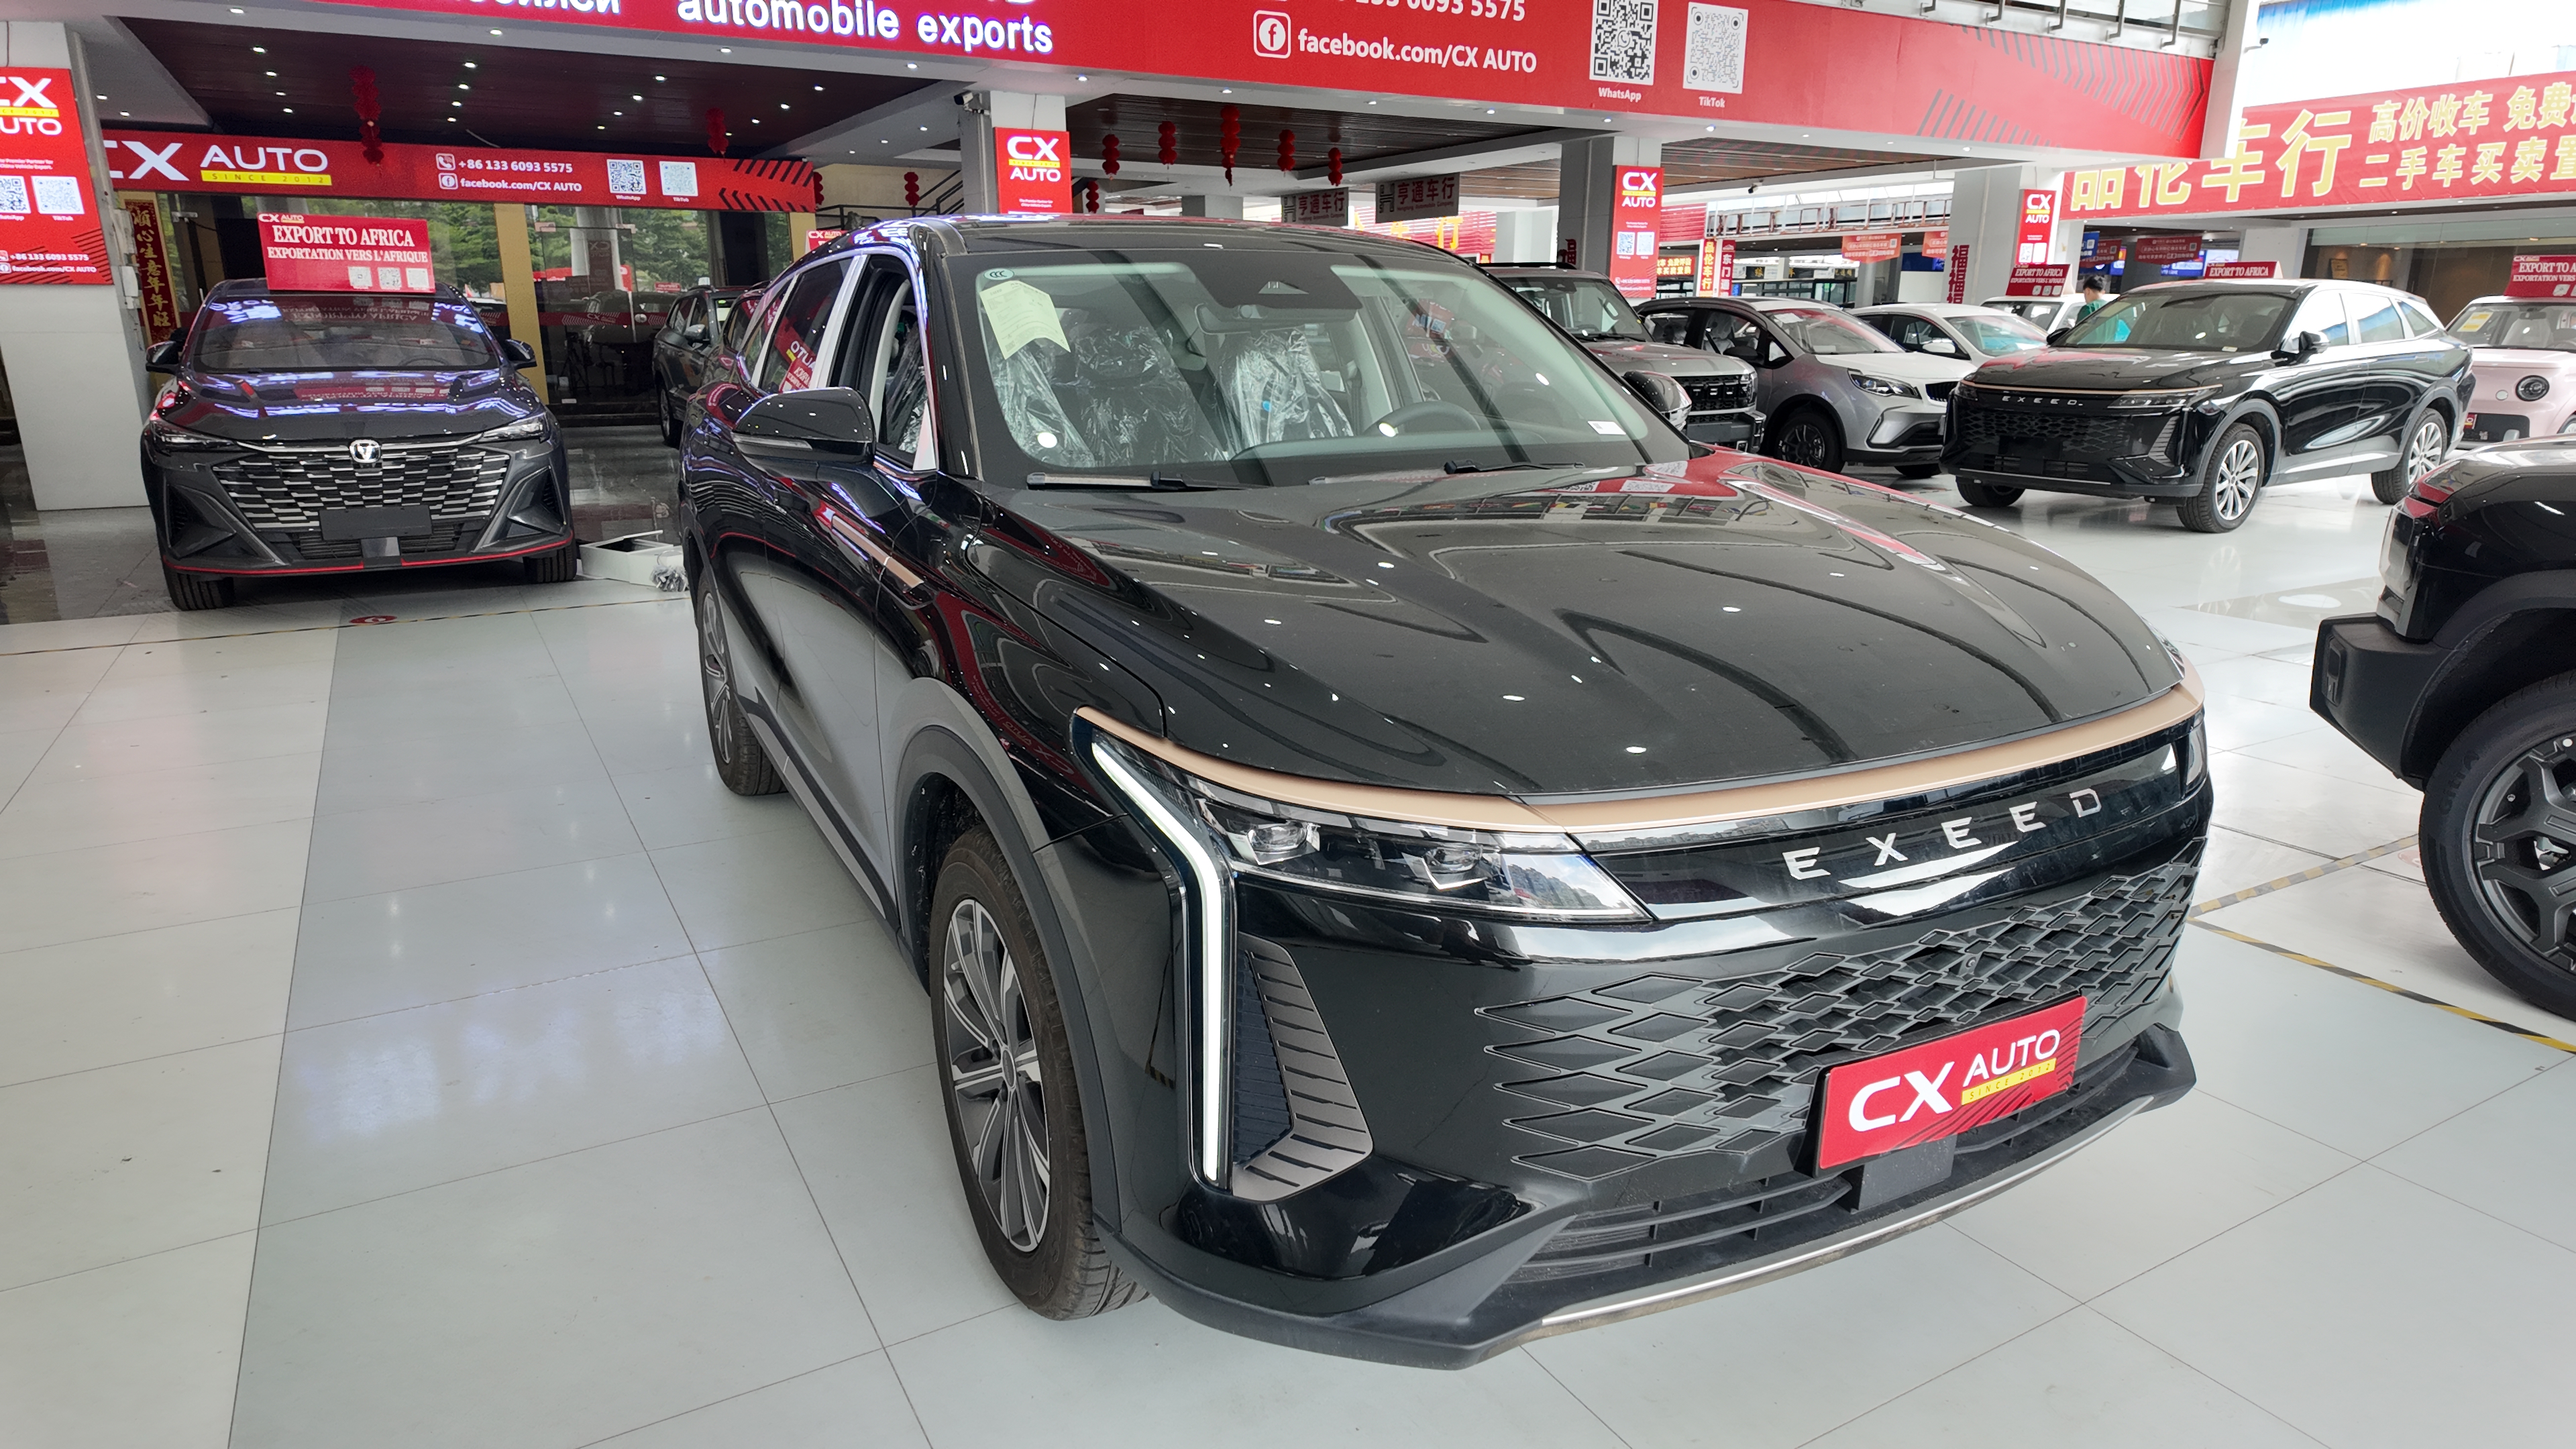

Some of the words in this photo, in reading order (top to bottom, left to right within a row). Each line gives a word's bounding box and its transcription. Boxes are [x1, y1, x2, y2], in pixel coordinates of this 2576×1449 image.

[1470, 0, 1525, 21] 5575
[678, 0, 900, 39] automobile
[917, 14, 1053, 54] exports
[1298, 28, 1479, 68] facebook.com/CX
[1483, 48, 1537, 72] AUTO
[1599, 87, 1642, 103] WhatsApp
[1699, 96, 1725, 108] TikTok
[2368, 90, 2493, 144] 高价收车
[2503, 81, 2576, 133] 免费
[0, 117, 62, 136] UTO
[1008, 137, 1060, 161] CX
[200, 144, 328, 172] AUTO
[2359, 134, 2576, 190] 二手车买卖置
[458, 160, 482, 170] +86
[486, 160, 508, 170] 133
[511, 161, 541, 172] 6093
[543, 162, 573, 173] 5575
[1010, 167, 1061, 182] AUTO
[212, 173, 266, 181] SINCE
[282, 175, 324, 183] 2012
[460, 178, 551, 191] facebook.com/CX
[553, 182, 582, 193] AUTO
[1623, 172, 1657, 191] CX
[1397, 177, 1454, 205] 亨通车行
[1299, 191, 1344, 215] 亨通车行
[1622, 197, 1656, 207] AUTO
[2027, 194, 2052, 209] CX
[258, 213, 280, 223] CX
[2025, 215, 2050, 223] AUTO
[272, 225, 334, 244] EXPORT
[335, 227, 358, 245] TO
[360, 229, 415, 247] AFRICA
[808, 230, 824, 239] CX
[267, 247, 344, 260] EXPORTATION
[345, 249, 375, 261] VERS
[374, 250, 429, 263] L'AFRIQUE
[2035, 268, 2044, 276] TO
[2043, 268, 2063, 276] AFRICA
[2209, 267, 2234, 276] EXPORT
[2235, 267, 2245, 276] TO
[2244, 266, 2269, 276] AFRICA
[2519, 262, 2556, 273] EXPORT
[2557, 262, 2569, 273] TO
[2002, 395, 2078, 406] EXEED
[1782, 788, 2102, 880] EXEED
[1848, 1061, 1955, 1132] CX
[1963, 1029, 2060, 1087] AUTO
[1969, 1079, 2009, 1100] SINCE
[2020, 1062, 2051, 1081] 2012
